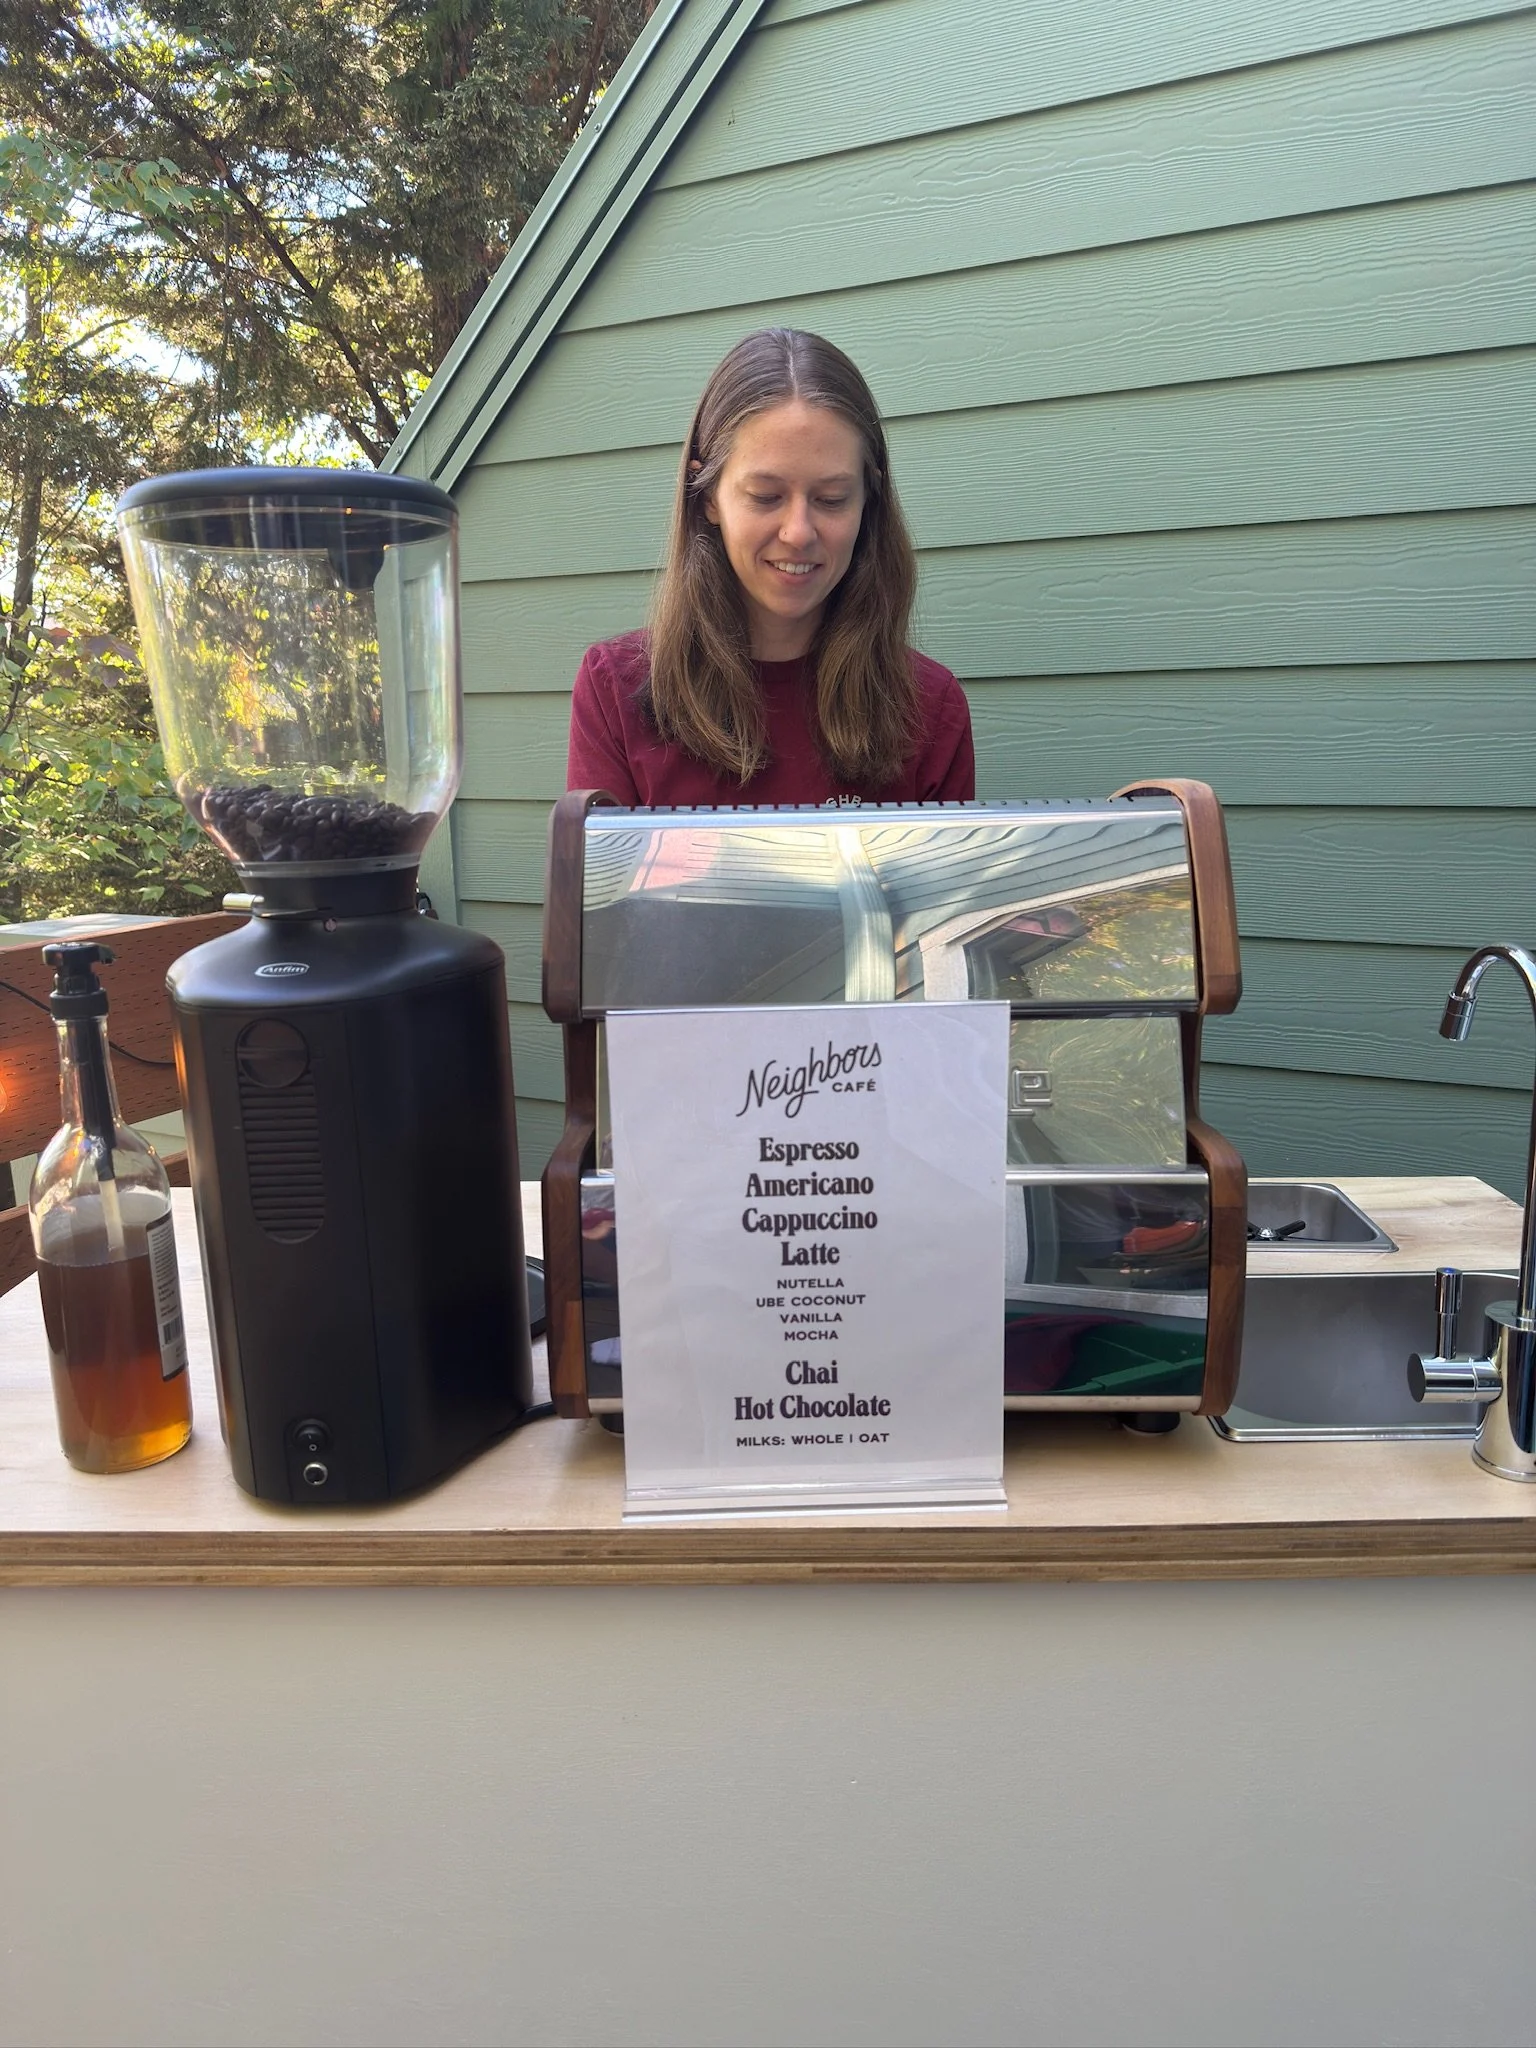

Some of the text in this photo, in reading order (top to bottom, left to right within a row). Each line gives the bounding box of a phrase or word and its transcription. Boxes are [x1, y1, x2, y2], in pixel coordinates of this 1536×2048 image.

[736, 1041, 882, 1118] Neighbors
[832, 1079, 876, 1093] CAFÉ
[759, 1137, 860, 1165] Espresso
[746, 1172, 875, 1198] Americano
[742, 1206, 878, 1237] Cappuccino
[781, 1241, 841, 1267] Latte
[776, 1278, 845, 1290] NUTELLA
[756, 1294, 867, 1308] UBE COCONUT
[779, 1312, 844, 1324] VANILLA
[784, 1330, 839, 1342] MOCHA
[785, 1360, 839, 1386] Chai
[734, 1393, 892, 1421] Hot Chocolate
[736, 1436, 786, 1448] MILKS:
[791, 1434, 844, 1446] WHOLE
[858, 1432, 891, 1444] OAT
